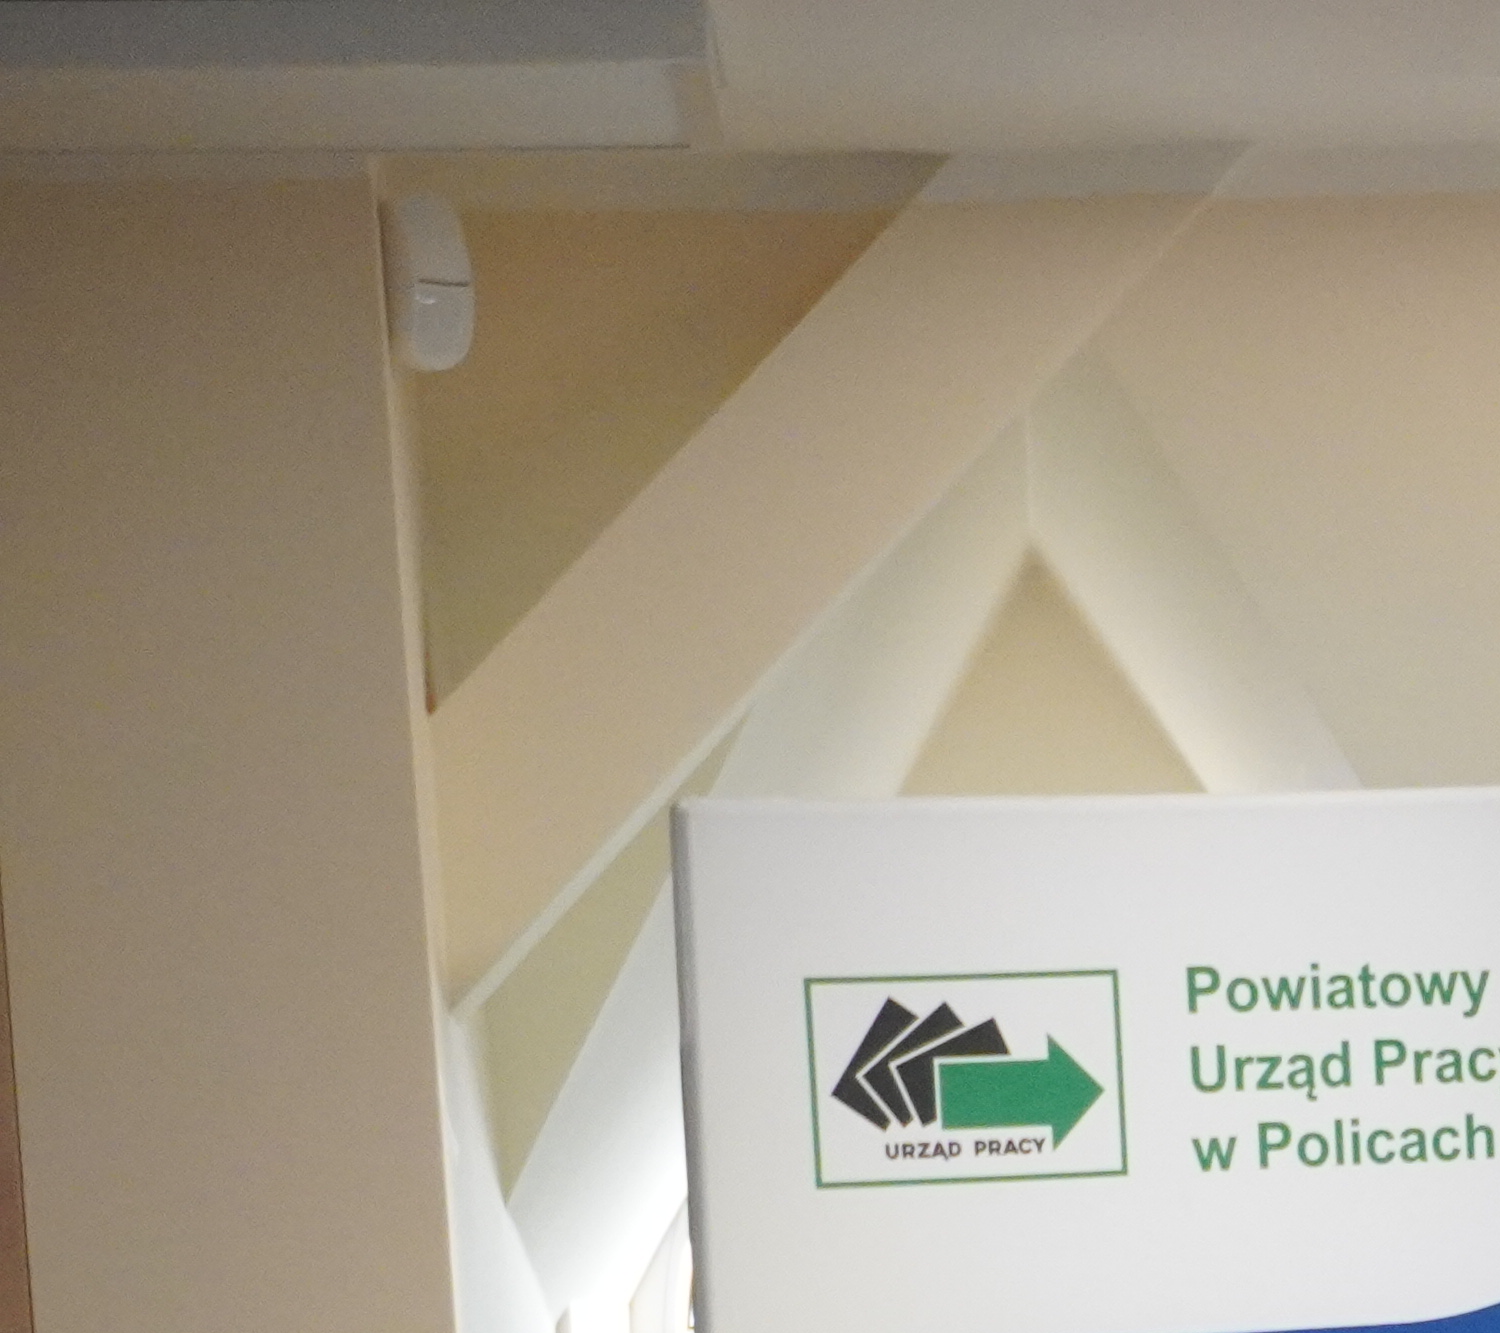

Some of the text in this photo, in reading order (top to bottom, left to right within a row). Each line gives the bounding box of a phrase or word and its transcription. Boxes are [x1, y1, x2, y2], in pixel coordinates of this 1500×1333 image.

[1186, 962, 1490, 1018] Powiatowy
[1190, 1040, 1352, 1102] Urząd
[885, 1138, 1046, 1161] URZĄD PRACY
[1192, 1113, 1495, 1172] w Policach
